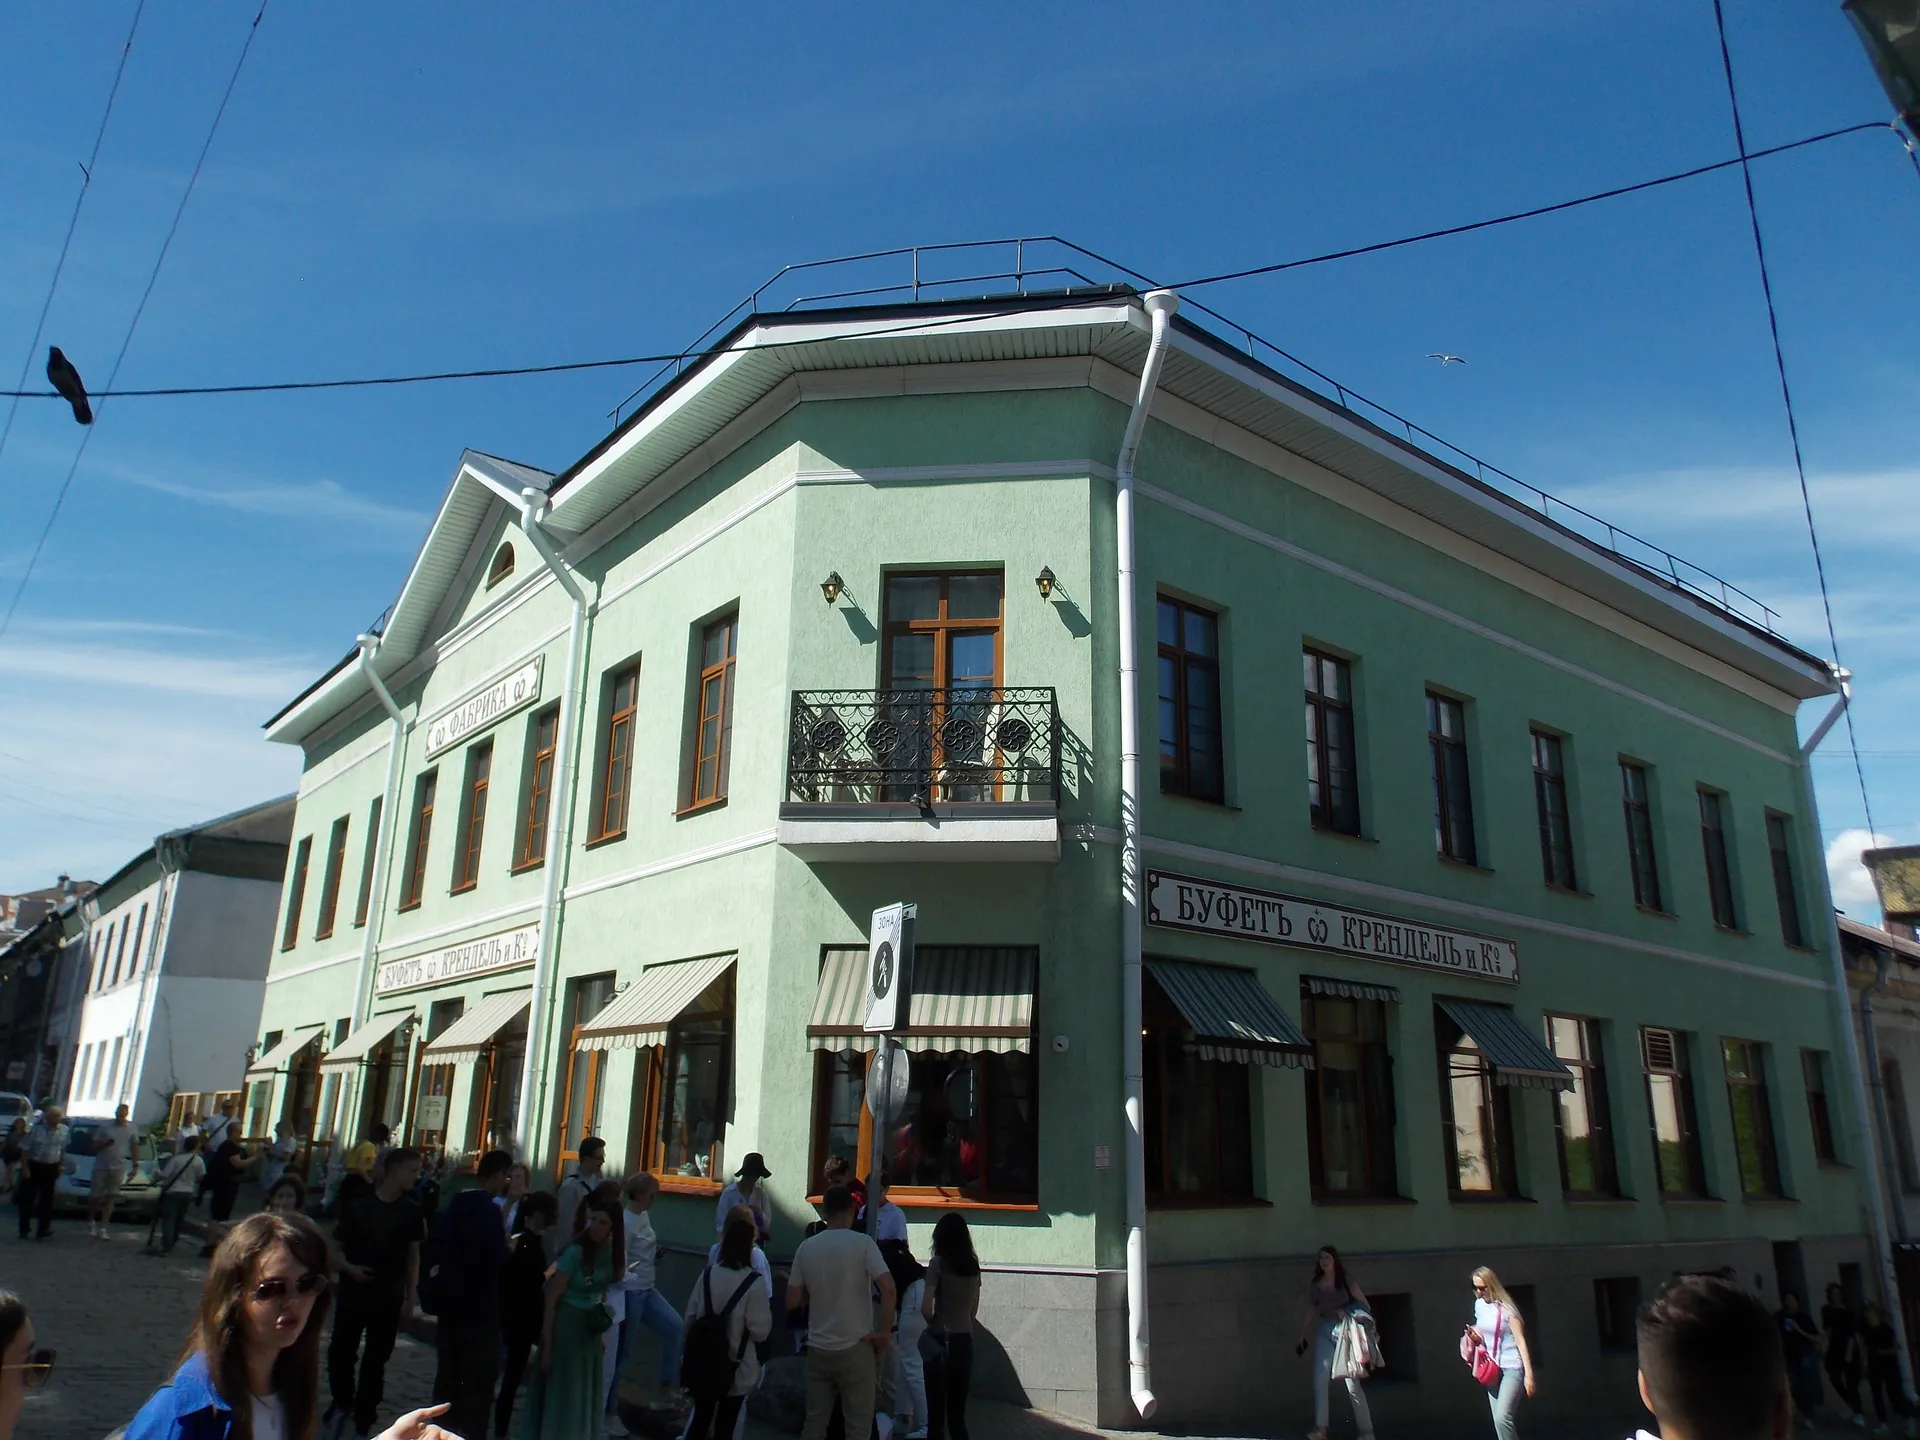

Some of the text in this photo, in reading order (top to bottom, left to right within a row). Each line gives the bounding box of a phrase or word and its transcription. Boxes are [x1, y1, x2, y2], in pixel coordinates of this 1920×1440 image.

[450, 683, 507, 736] ФАБРИКА
[878, 914, 895, 930] ЗОНА
[1177, 885, 1292, 936] БУФЕТЪ
[1341, 916, 1461, 966] КРЕНДЕЛЬ
[1465, 949, 1477, 969] и
[384, 960, 422, 988] БУФЕТЪ
[441, 939, 502, 976] КРЕНДЕЛЬ
